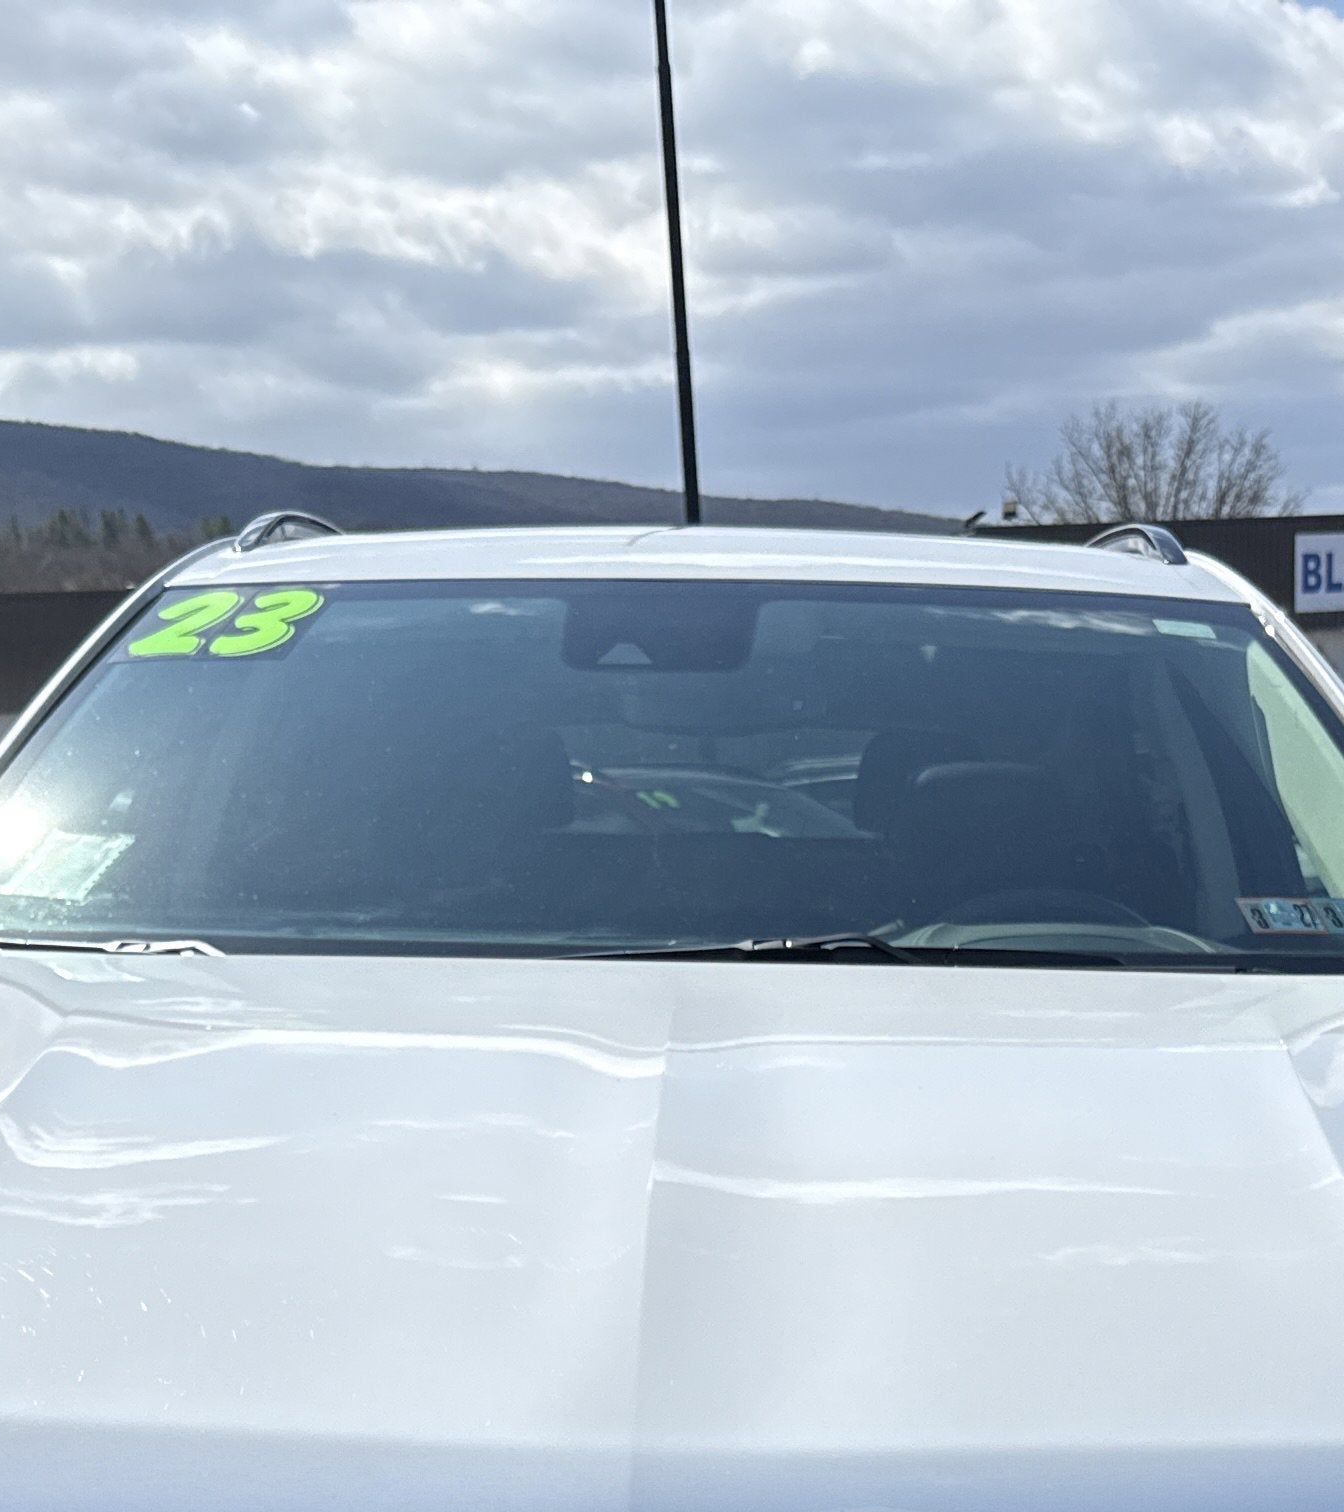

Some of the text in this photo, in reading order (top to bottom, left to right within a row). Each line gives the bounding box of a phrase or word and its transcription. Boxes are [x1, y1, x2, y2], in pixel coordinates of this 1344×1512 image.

[128, 589, 324, 657] 23
[1250, 903, 1318, 929] 3 27
[1323, 906, 1344, 928] 3
